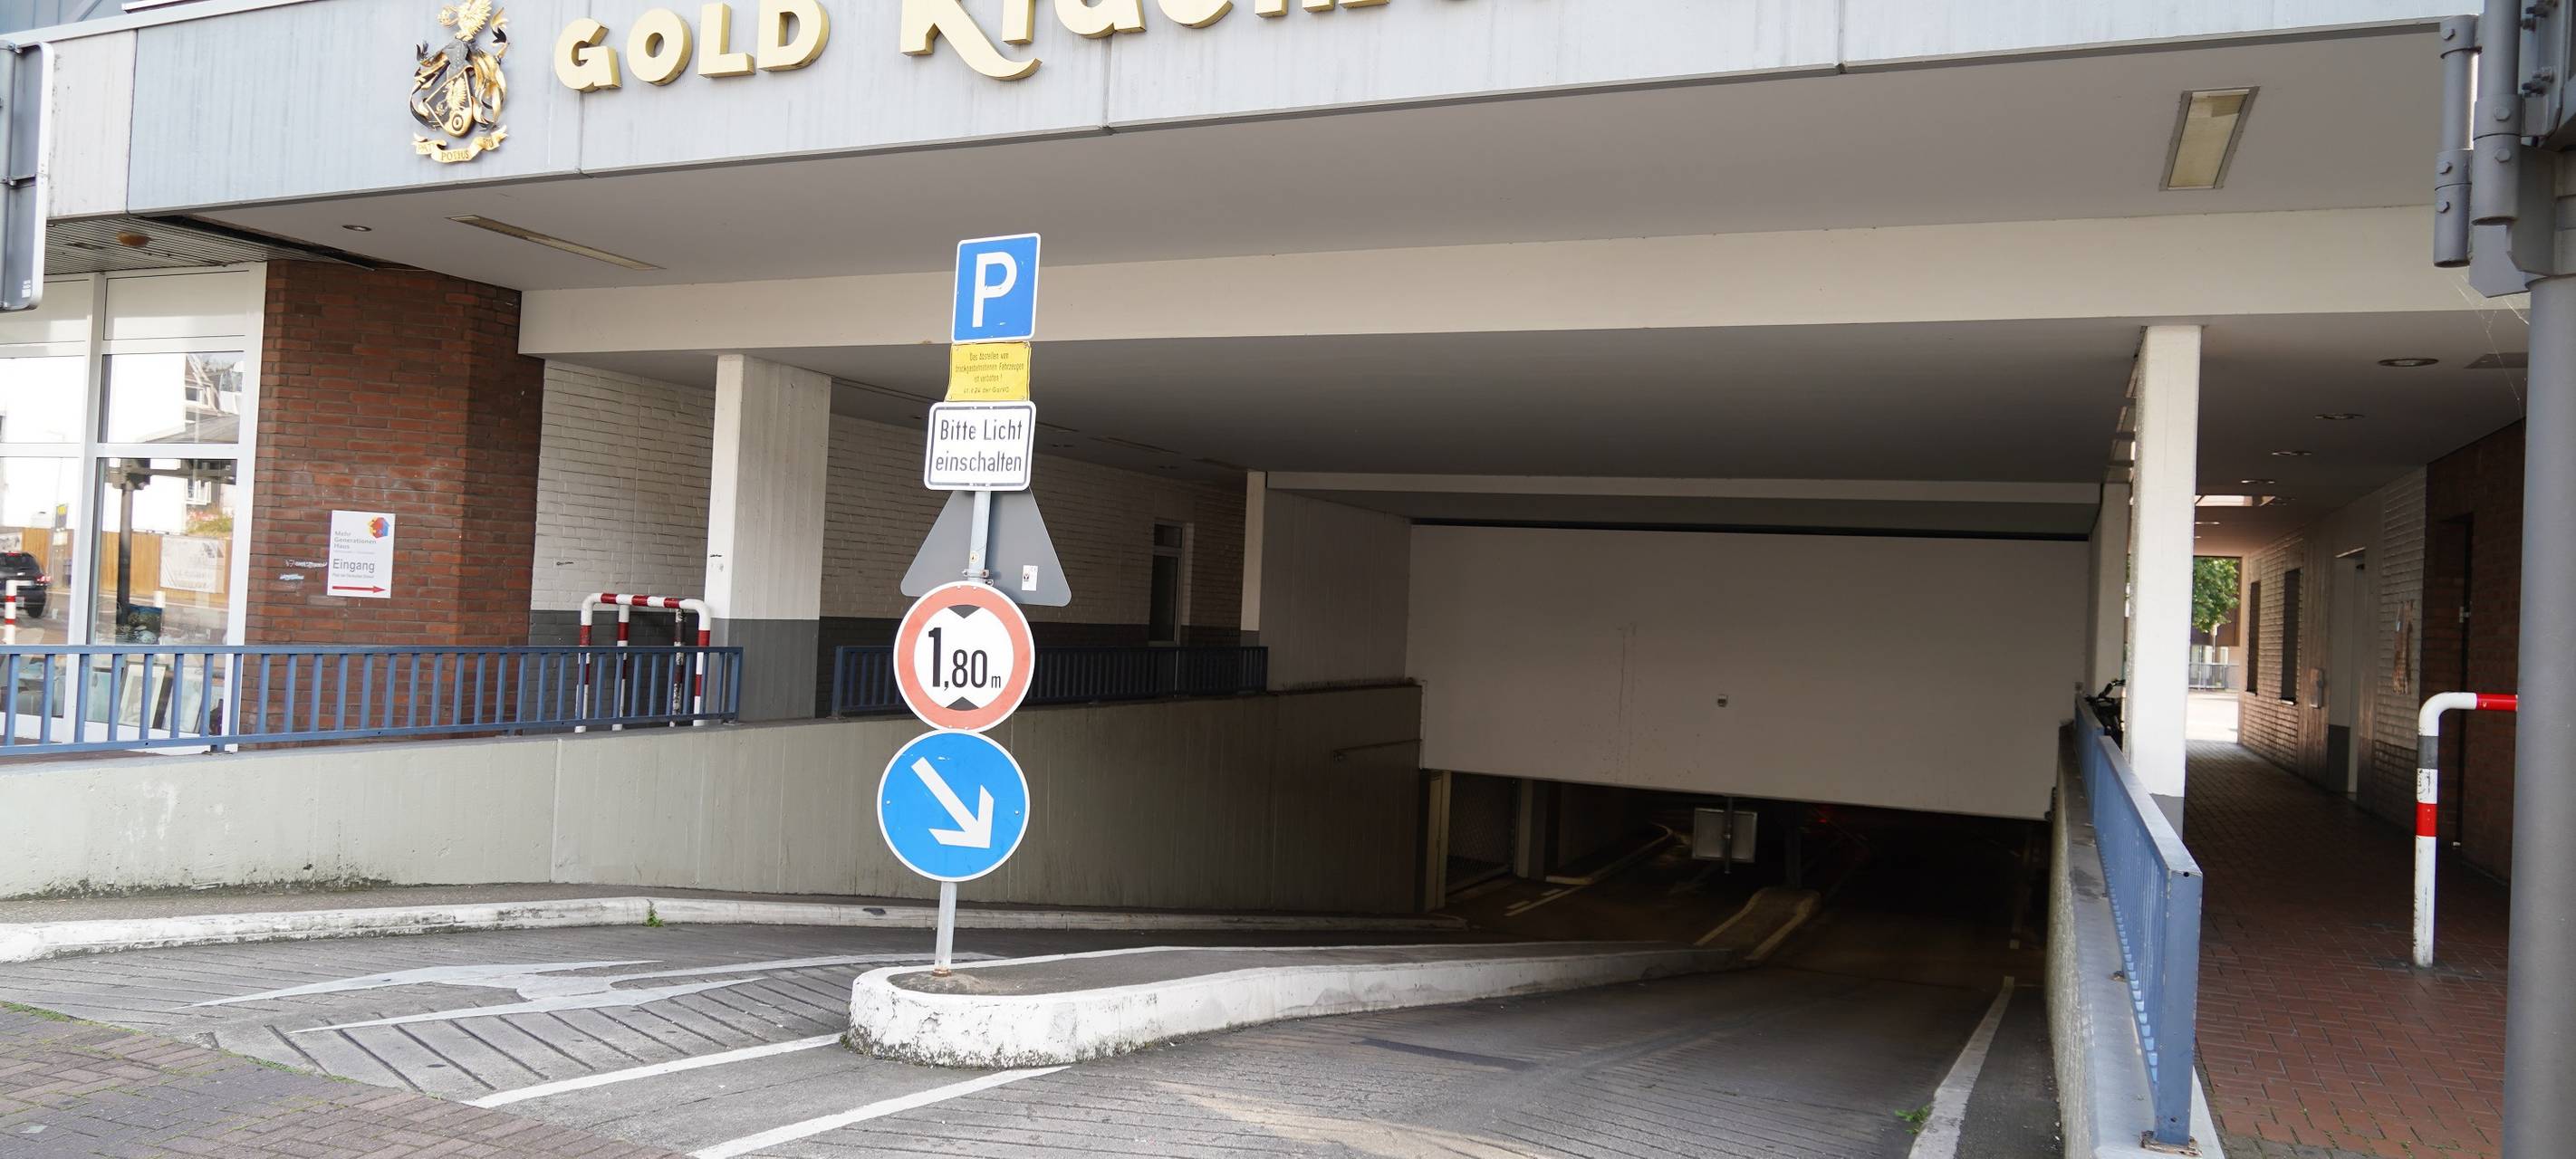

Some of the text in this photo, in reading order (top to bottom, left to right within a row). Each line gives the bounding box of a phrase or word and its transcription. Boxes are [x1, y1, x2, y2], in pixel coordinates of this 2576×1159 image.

[554, 0, 830, 91] GOLD
[972, 252, 1017, 327] P
[940, 419, 1022, 440] Bitte Licht
[935, 450, 1022, 472] einschalten
[332, 559, 375, 574] Eingang
[928, 627, 1001, 690] 1,80 m
